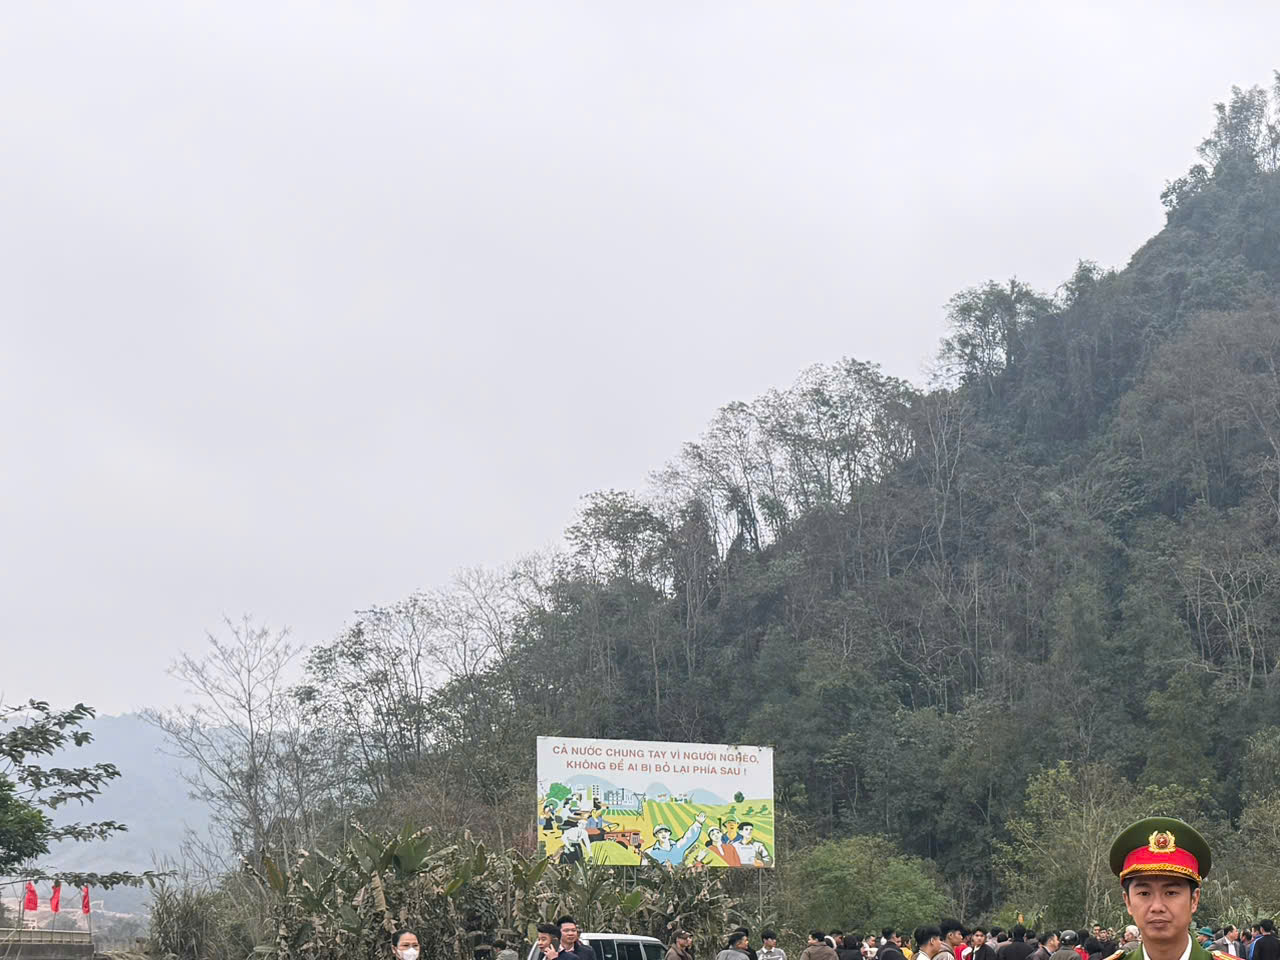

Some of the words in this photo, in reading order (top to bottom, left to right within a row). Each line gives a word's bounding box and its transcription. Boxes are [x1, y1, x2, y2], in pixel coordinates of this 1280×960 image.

[552, 743, 568, 755] CẢ
[571, 745, 602, 756] NƯỚC
[606, 748, 645, 758] CHUNG
[648, 750, 667, 759] TAY
[670, 748, 680, 760] VÌ
[683, 751, 717, 761] NGƯỜI
[566, 760, 606, 770] KHÔNG
[609, 758, 624, 771] ĐỂ
[627, 762, 638, 771] AI
[641, 763, 651, 774] BỊ
[655, 761, 671, 773] BỎ
[673, 765, 690, 775] LẠI
[693, 764, 717, 775] PHÍA
[720, 766, 741, 776] SAU
